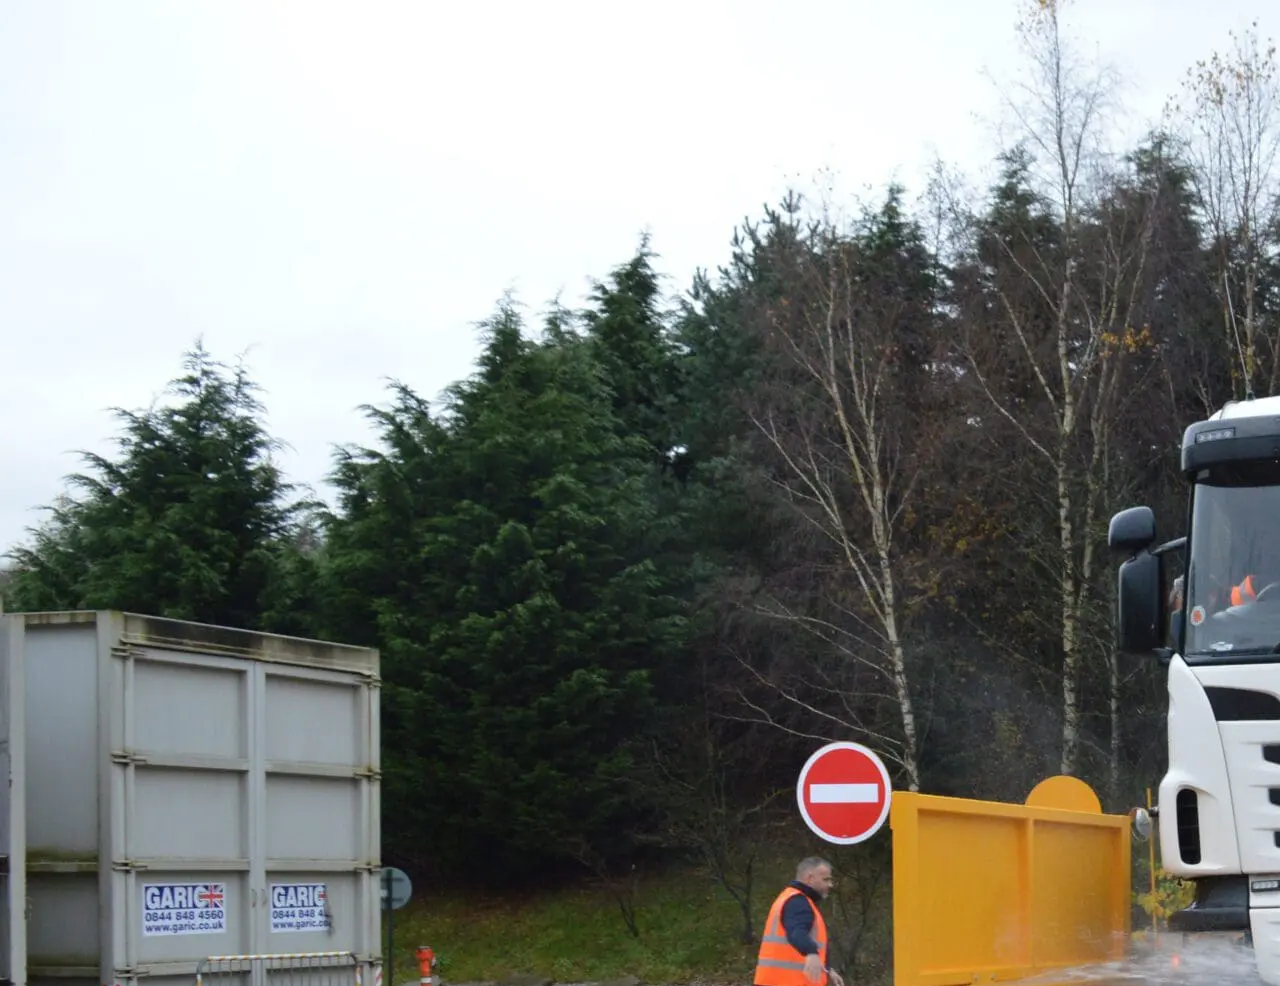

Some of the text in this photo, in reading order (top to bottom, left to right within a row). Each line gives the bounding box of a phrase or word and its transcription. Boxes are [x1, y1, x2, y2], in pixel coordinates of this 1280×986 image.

[146, 886, 209, 910] GARIC
[145, 910, 224, 922] 0844 848 4560
[272, 910, 296, 919] 0844
[298, 909, 316, 918] 848
[145, 921, 224, 934] www.garic.co.uk
